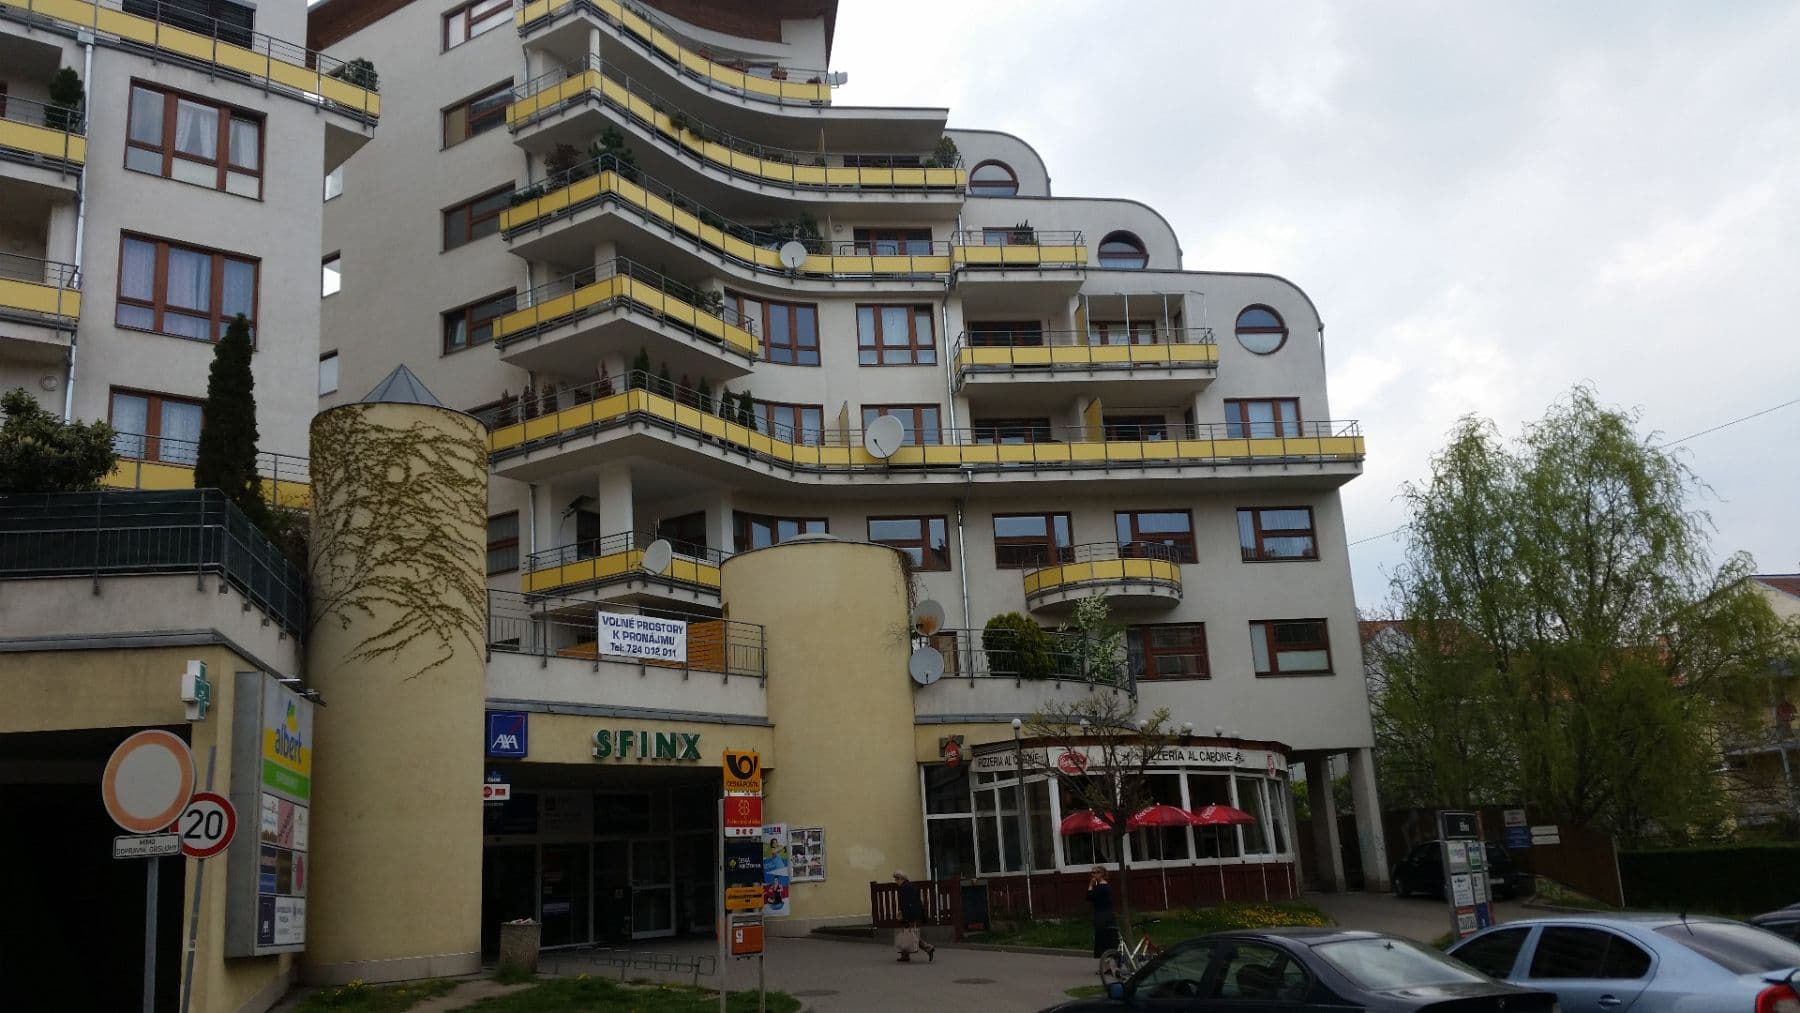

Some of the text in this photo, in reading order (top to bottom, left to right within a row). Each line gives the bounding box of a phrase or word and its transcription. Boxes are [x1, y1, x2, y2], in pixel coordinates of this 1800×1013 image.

[602, 616, 684, 634] VOLNÉ PROSTORY
[612, 630, 675, 645] K PRONÁJMU
[626, 644, 642, 654] 724
[644, 646, 661, 656] 012
[662, 648, 677, 658] 011
[275, 723, 303, 765] albert
[491, 733, 519, 750] AXA
[592, 728, 702, 761] SFINX
[1188, 751, 1198, 761] AL
[183, 809, 224, 840] 20
